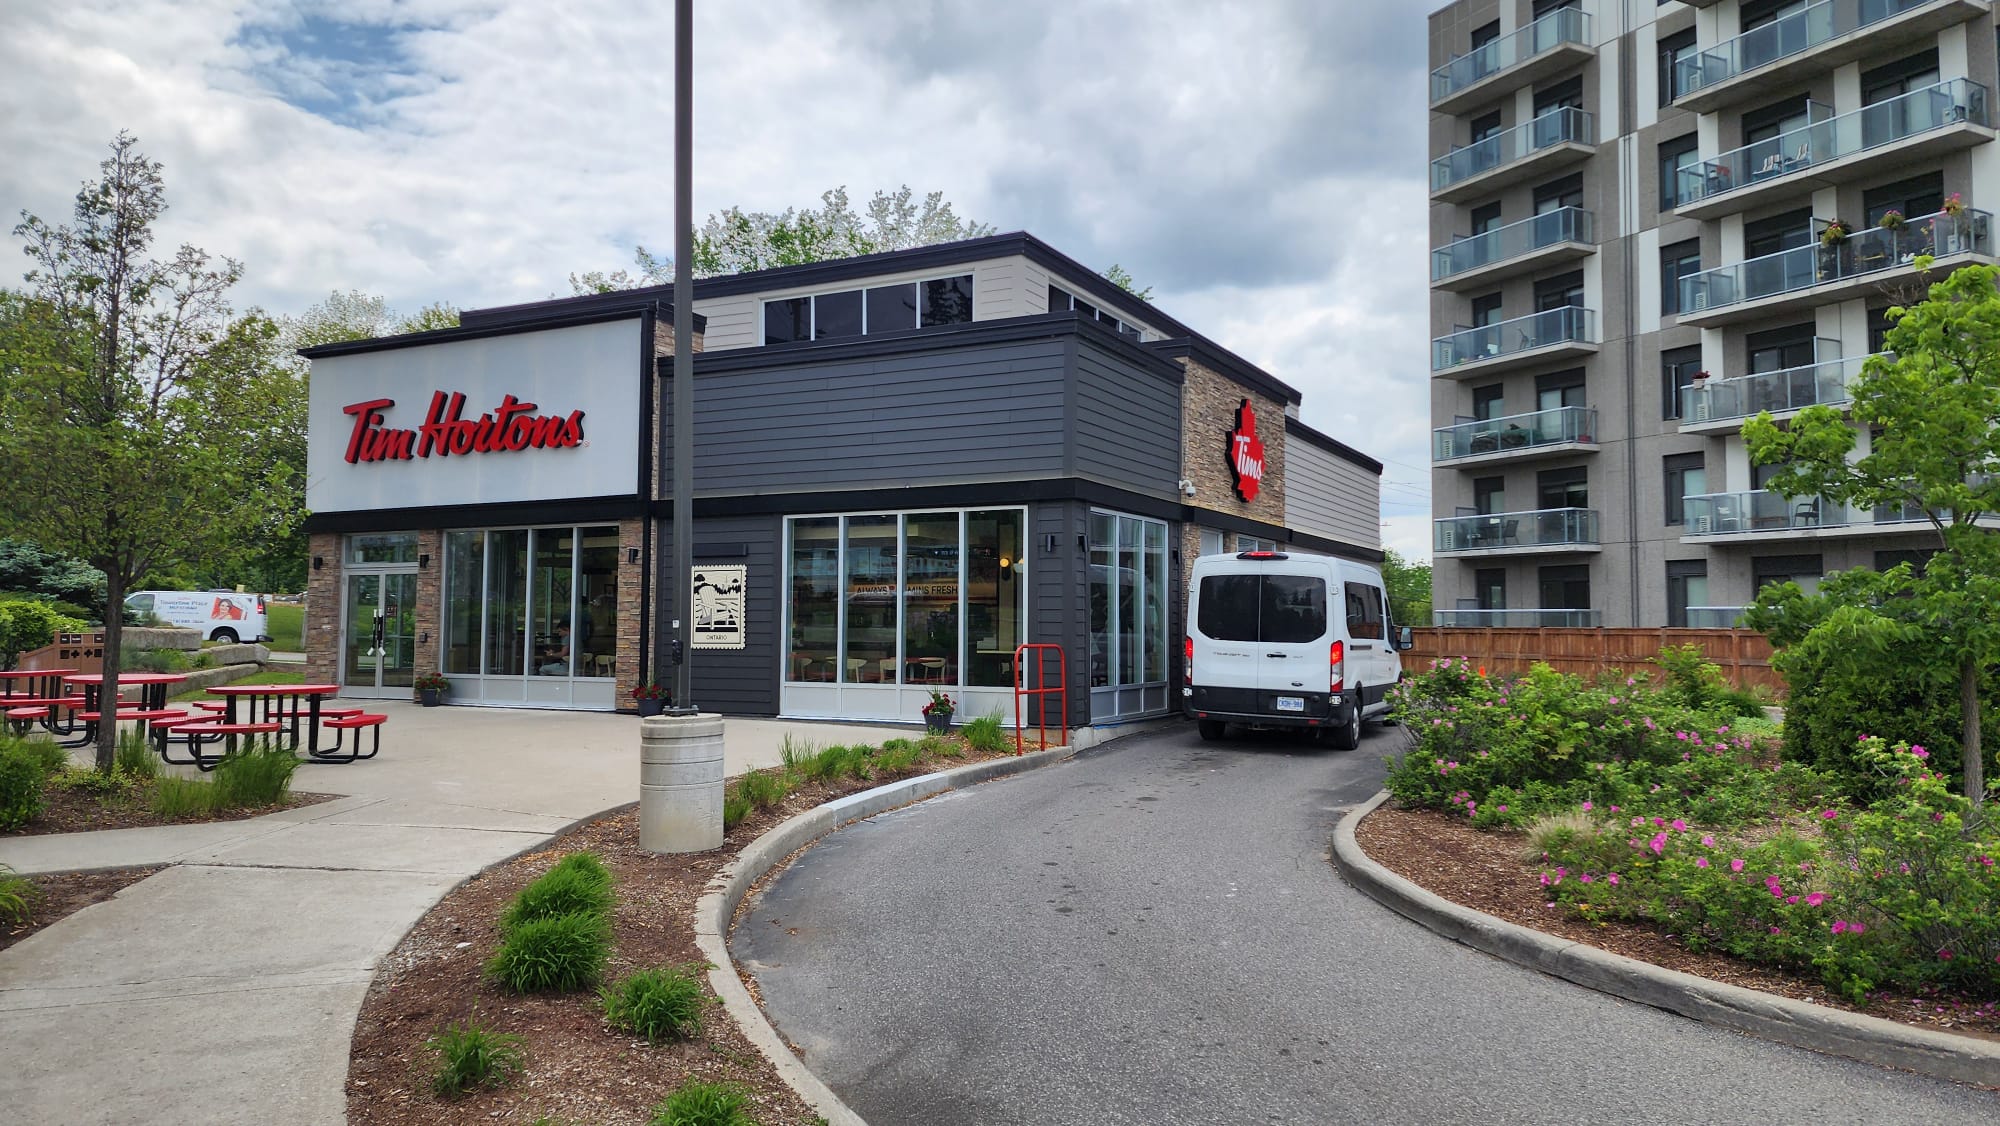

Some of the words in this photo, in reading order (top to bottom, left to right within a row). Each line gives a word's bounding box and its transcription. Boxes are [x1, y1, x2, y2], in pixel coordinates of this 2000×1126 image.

[343, 398, 417, 464] Tim
[417, 390, 586, 458] Hortons
[1235, 435, 1262, 480] Tims
[931, 585, 958, 595] FRESH
